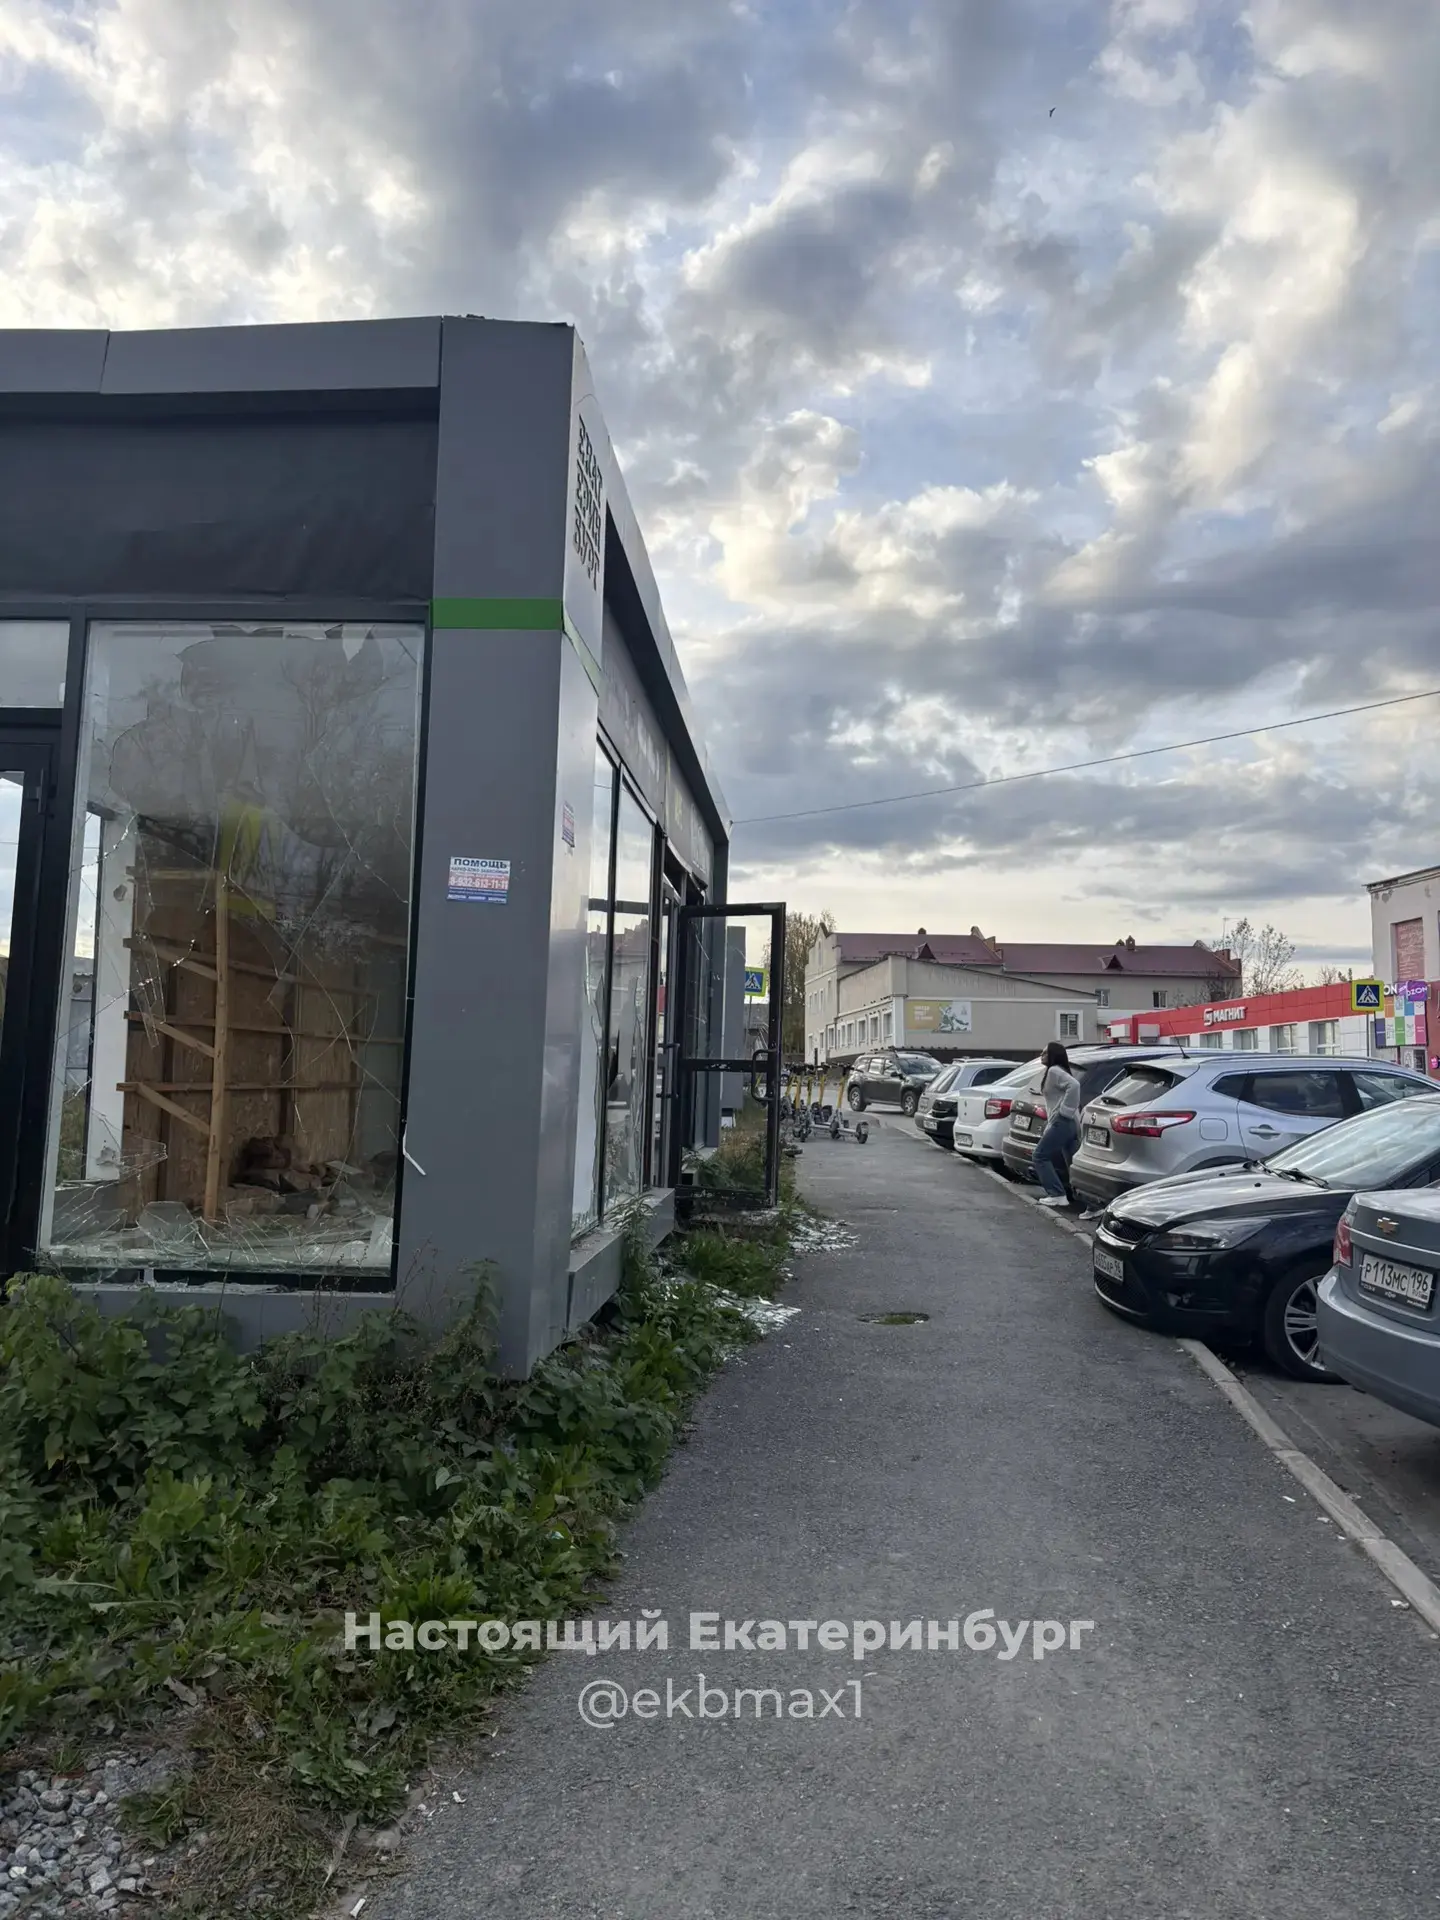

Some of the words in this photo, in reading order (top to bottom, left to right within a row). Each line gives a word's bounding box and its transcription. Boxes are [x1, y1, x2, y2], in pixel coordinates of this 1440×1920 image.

[453, 858, 507, 869] ПОМОЩЬ
[1213, 1006, 1246, 1023] МАГНИТ
[1364, 1261, 1408, 1292] Р113МС
[1410, 1271, 1429, 1292] 196
